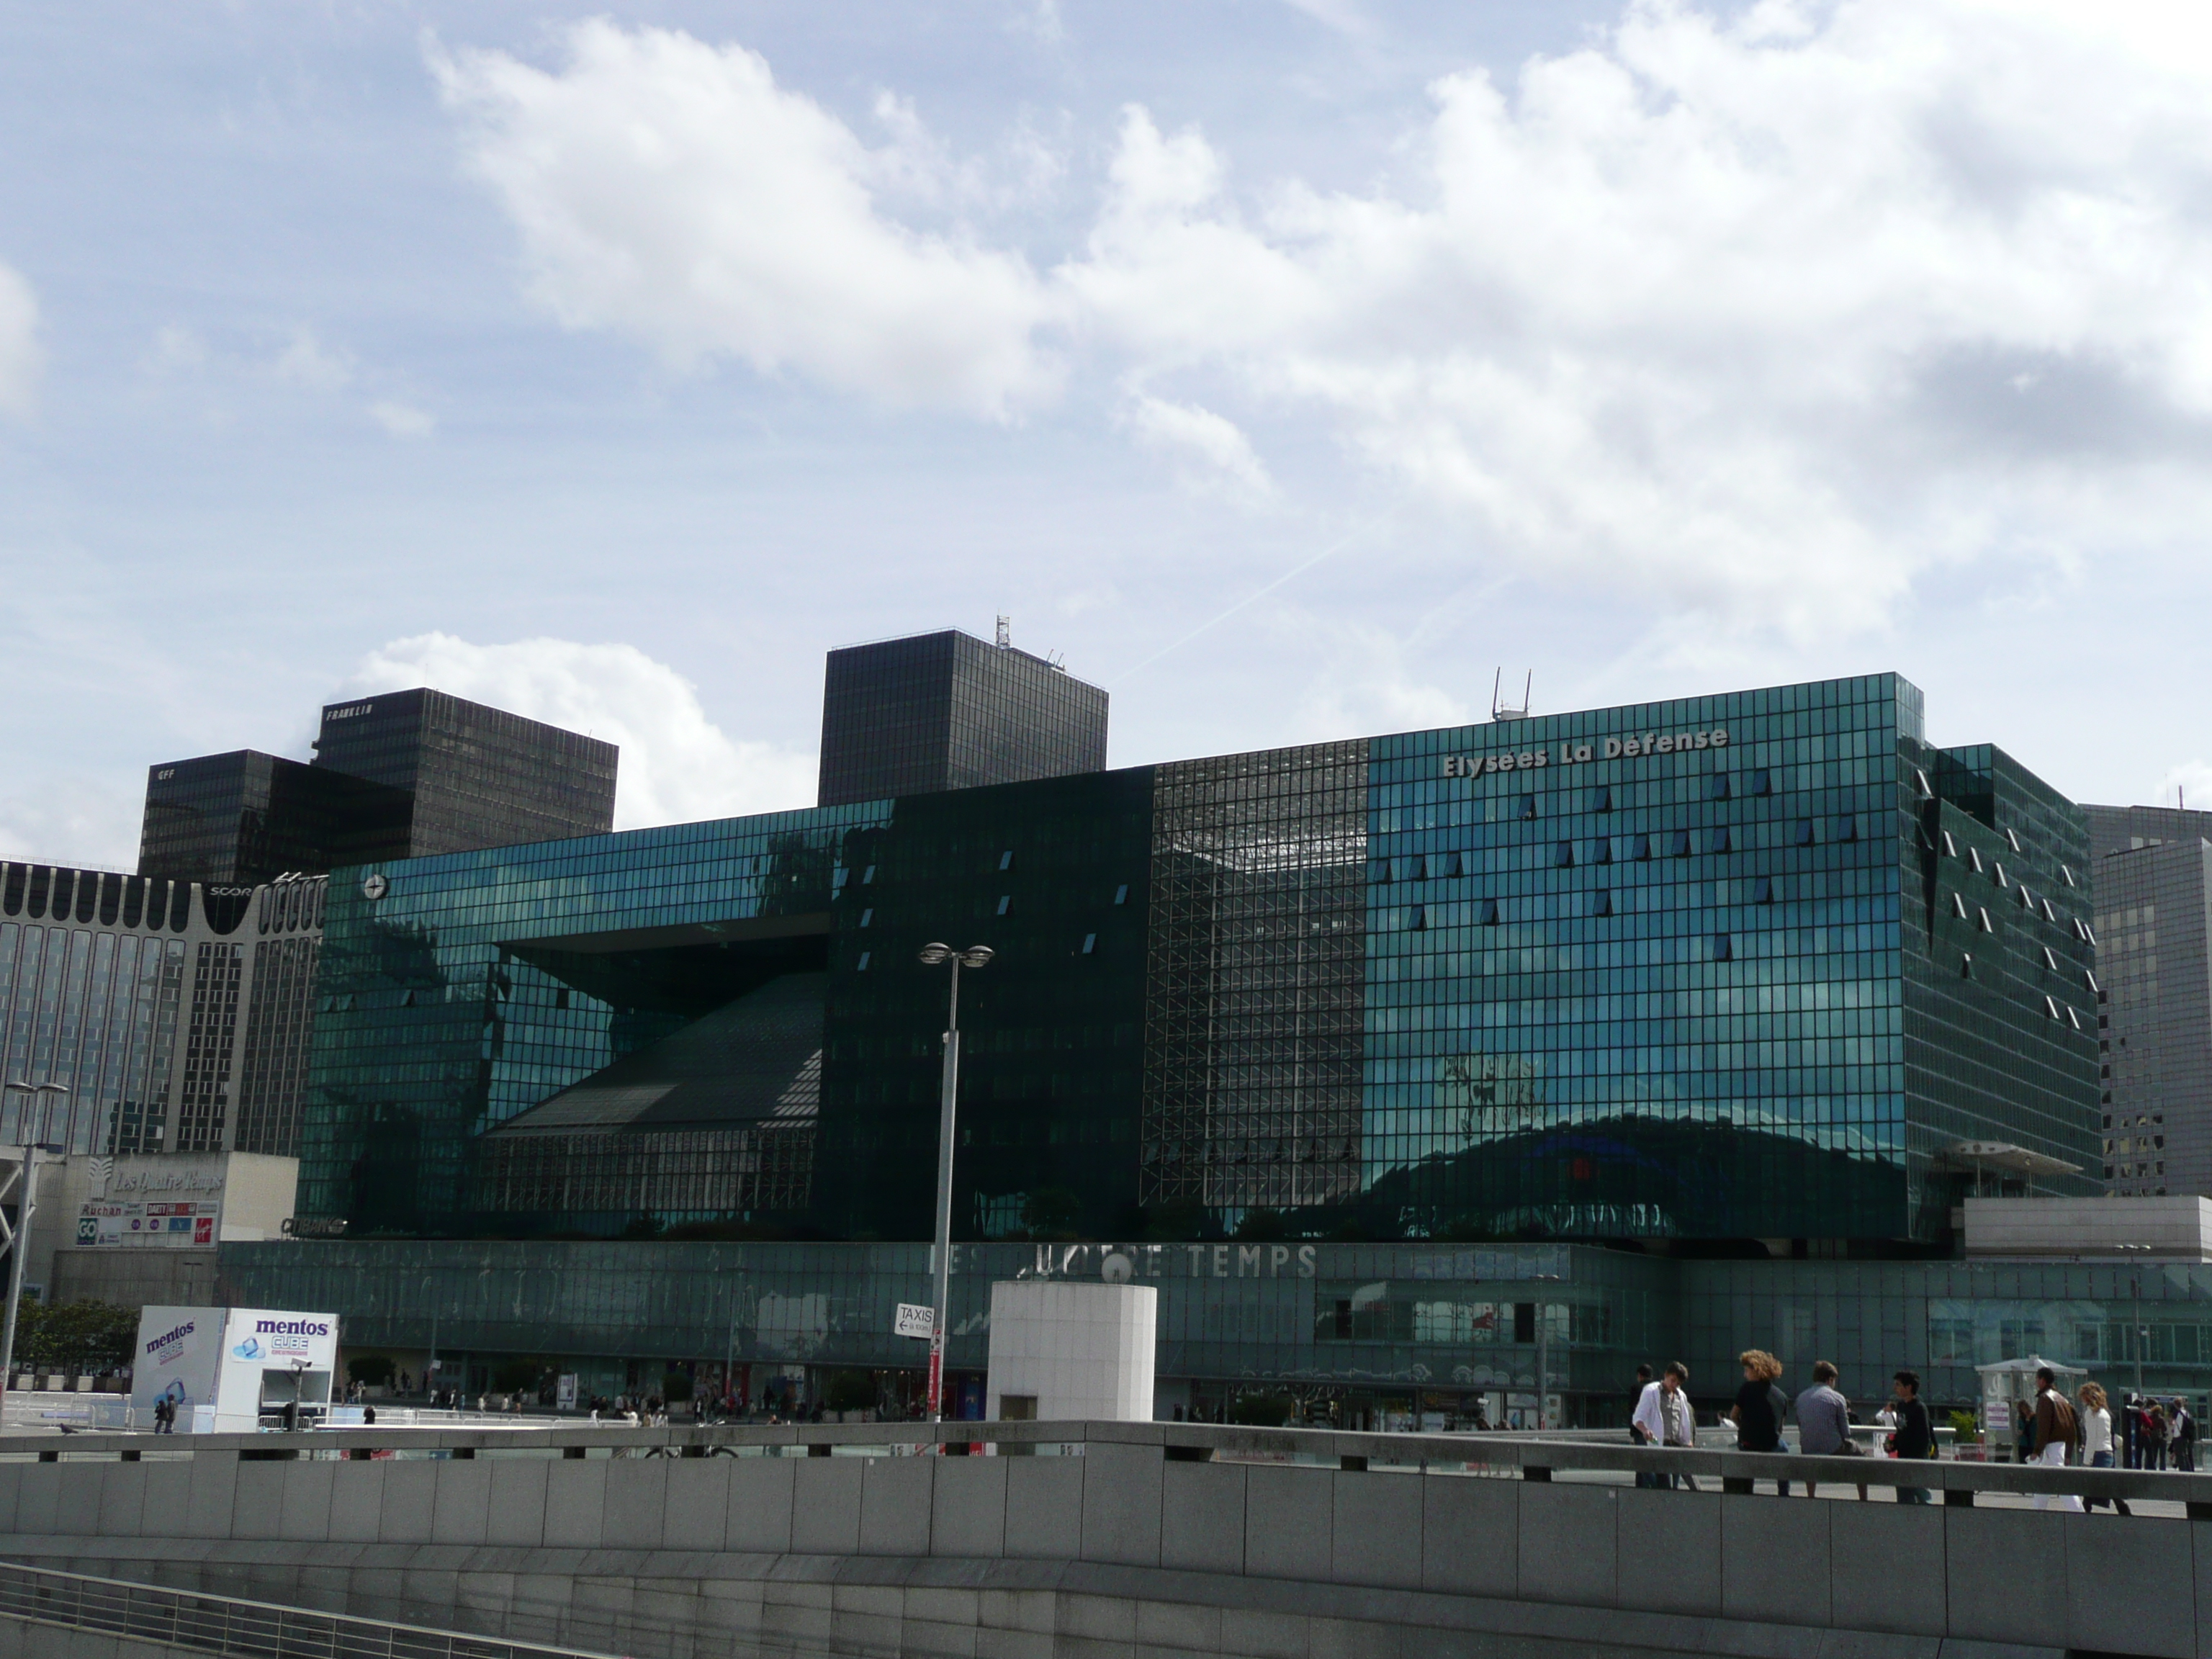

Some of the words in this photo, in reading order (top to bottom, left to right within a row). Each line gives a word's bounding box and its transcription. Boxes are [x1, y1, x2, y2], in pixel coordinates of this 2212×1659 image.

[326, 704, 372, 721] FRANKLIN
[1443, 750, 1548, 778] Elysées
[1561, 743, 1592, 764] La
[1604, 729, 1728, 759] Défense
[210, 886, 252, 896] SCOR
[114, 1173, 138, 1192] Les
[82, 1203, 122, 1216] Auchan
[148, 1204, 167, 1214] DARTY
[79, 1221, 96, 1237] GO
[1187, 1245, 1316, 1278] TEMPS
[901, 1307, 932, 1323] TAXIS
[256, 1319, 328, 1336] mentos
[146, 1321, 194, 1354] mentos
[271, 1336, 309, 1350] CUBE
[159, 1339, 184, 1361] CUBE
